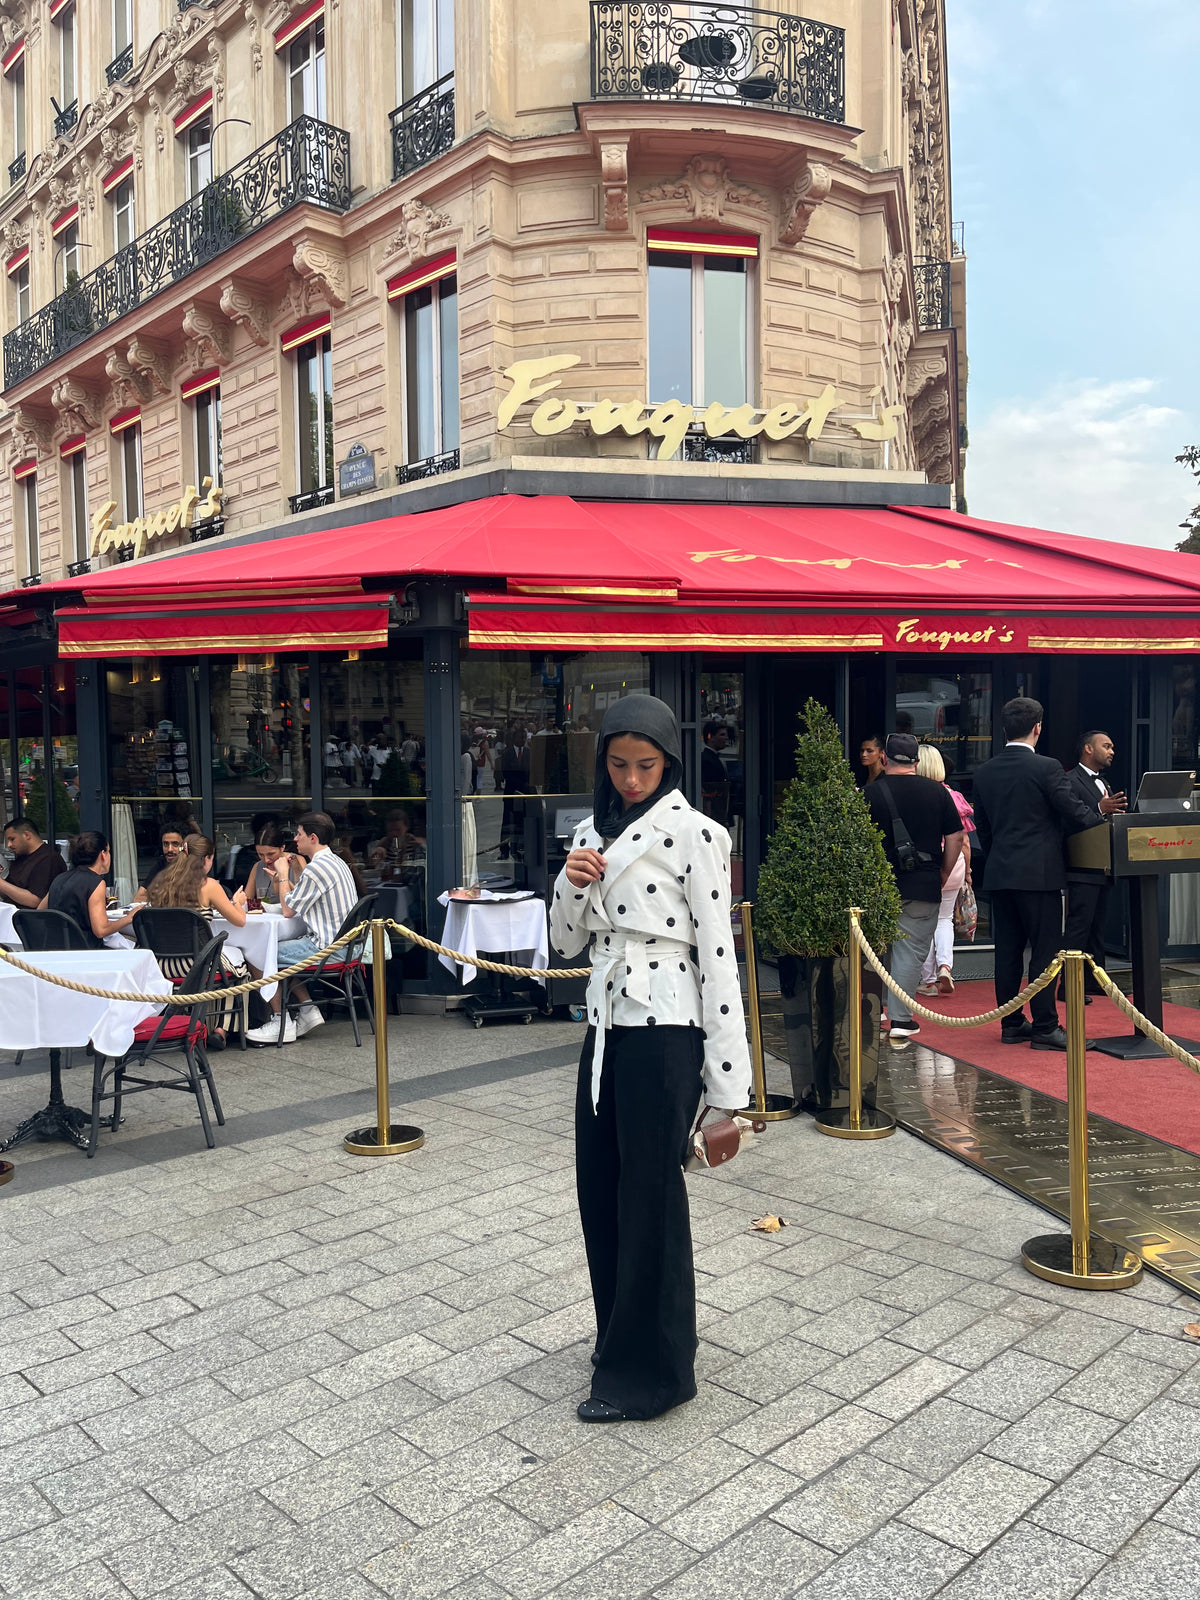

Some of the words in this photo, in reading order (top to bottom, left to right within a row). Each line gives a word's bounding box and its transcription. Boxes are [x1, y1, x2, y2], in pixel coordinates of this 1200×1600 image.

[497, 354, 905, 460] Fouquet's
[90, 476, 223, 560] Fouquet's
[896, 618, 1015, 651] Fouquet's
